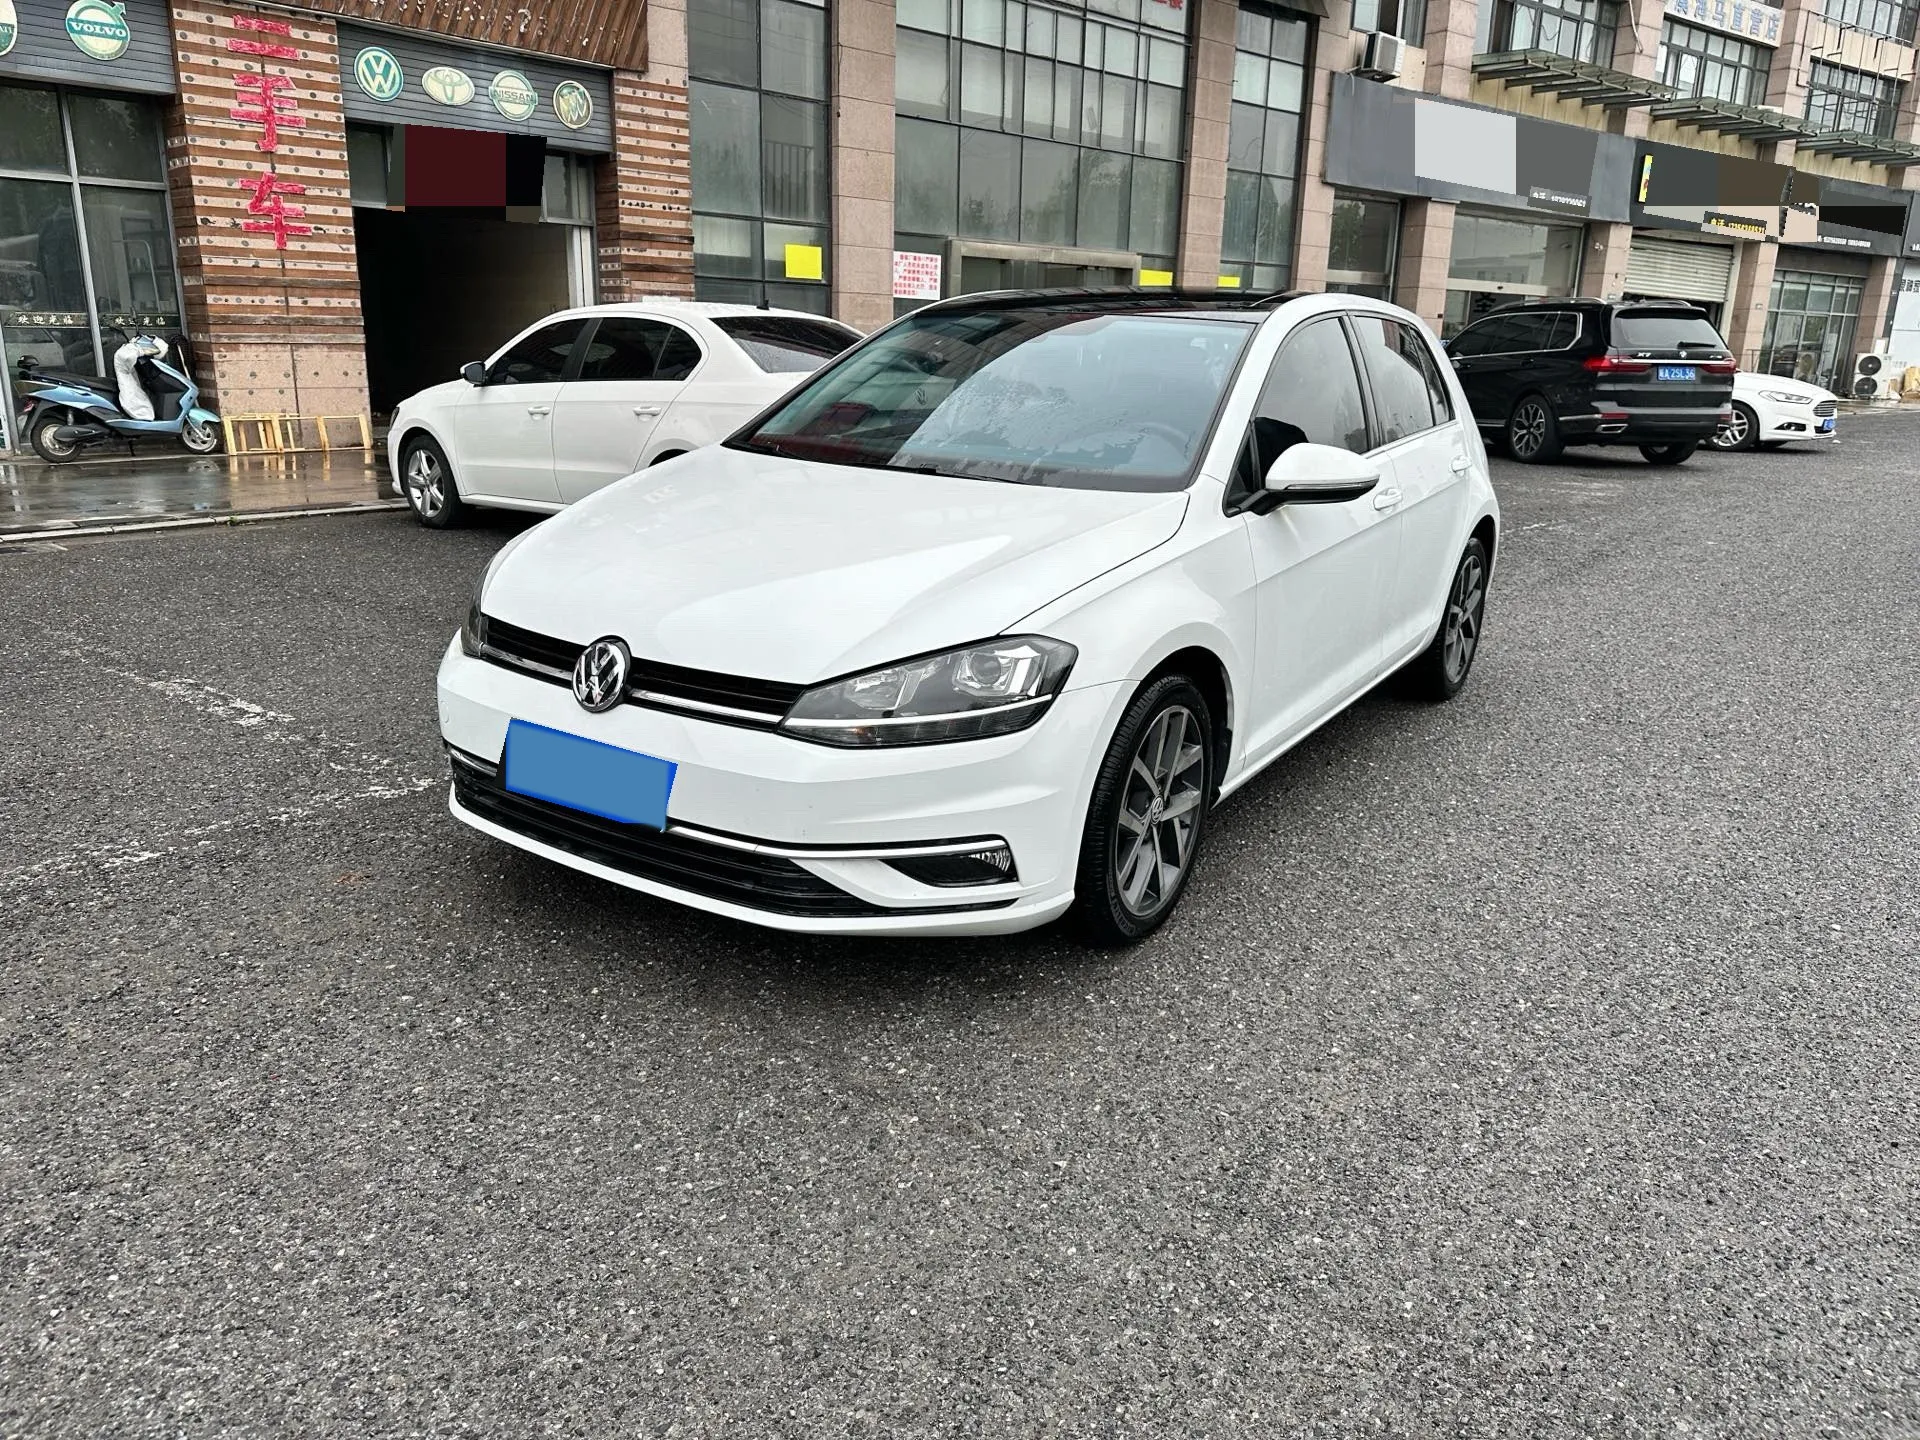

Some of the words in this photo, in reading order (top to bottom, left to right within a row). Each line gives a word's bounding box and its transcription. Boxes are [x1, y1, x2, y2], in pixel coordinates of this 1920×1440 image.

[69, 22, 127, 37] VOLVO
[494, 88, 535, 104] NISSAN
[226, 14, 313, 250] 二手车
[18, 314, 74, 325] 欢迎光临
